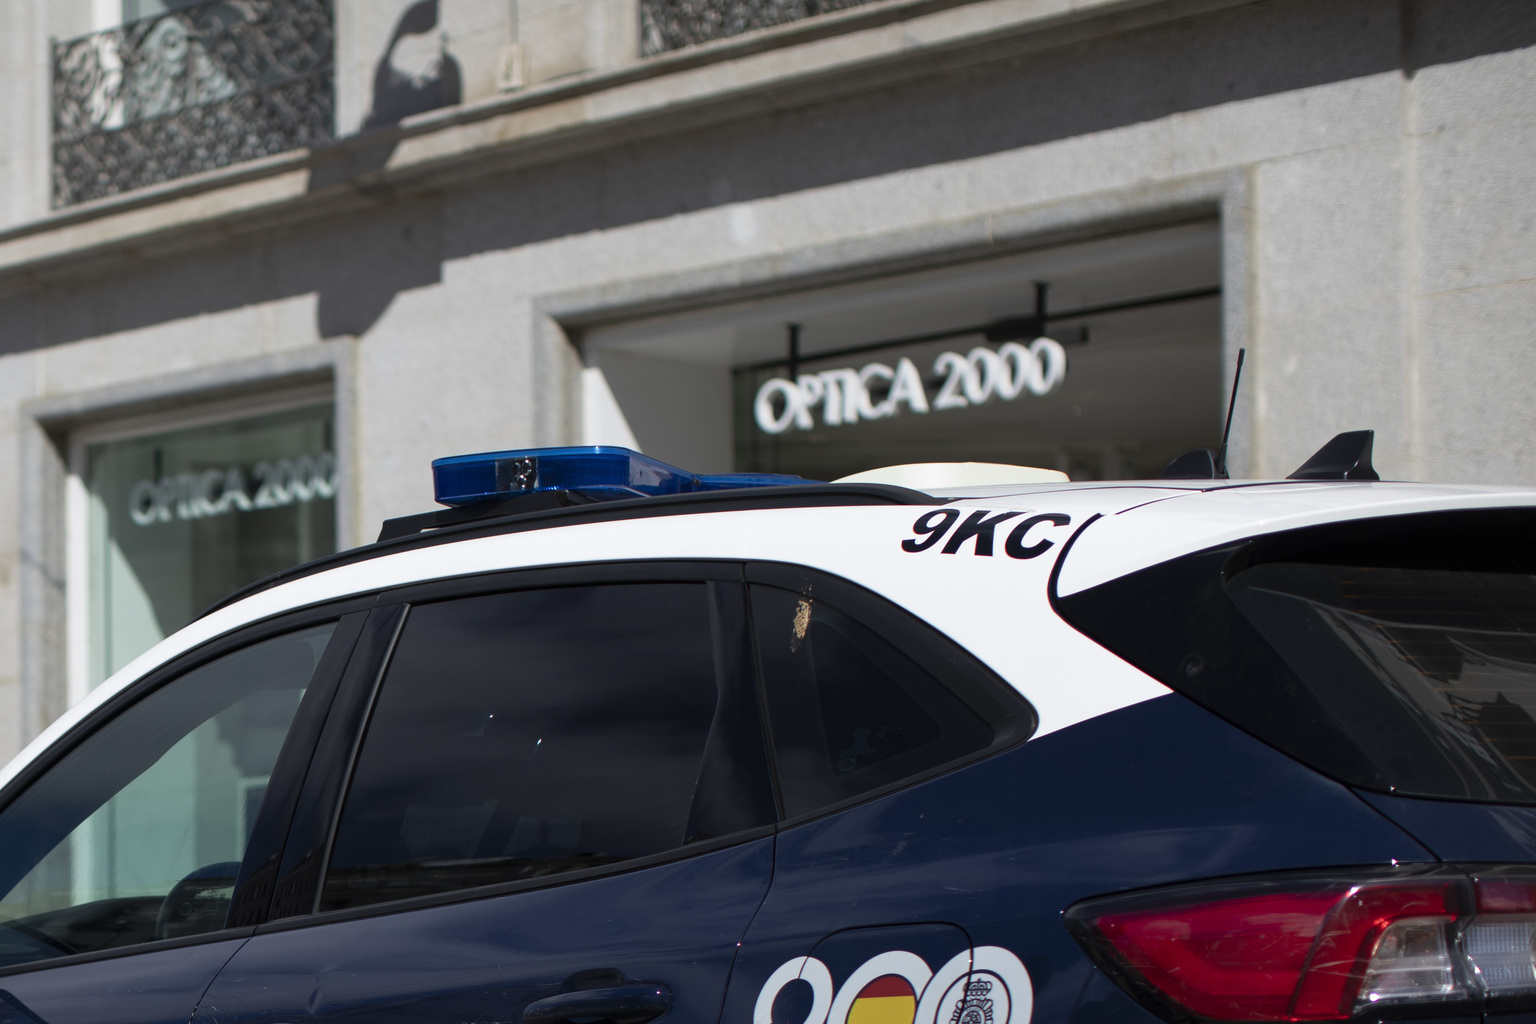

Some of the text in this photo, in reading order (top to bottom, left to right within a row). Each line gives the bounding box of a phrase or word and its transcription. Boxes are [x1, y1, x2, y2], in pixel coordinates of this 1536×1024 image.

[754, 337, 1066, 434] OPTICA 2000
[901, 508, 1071, 560] 9KC
